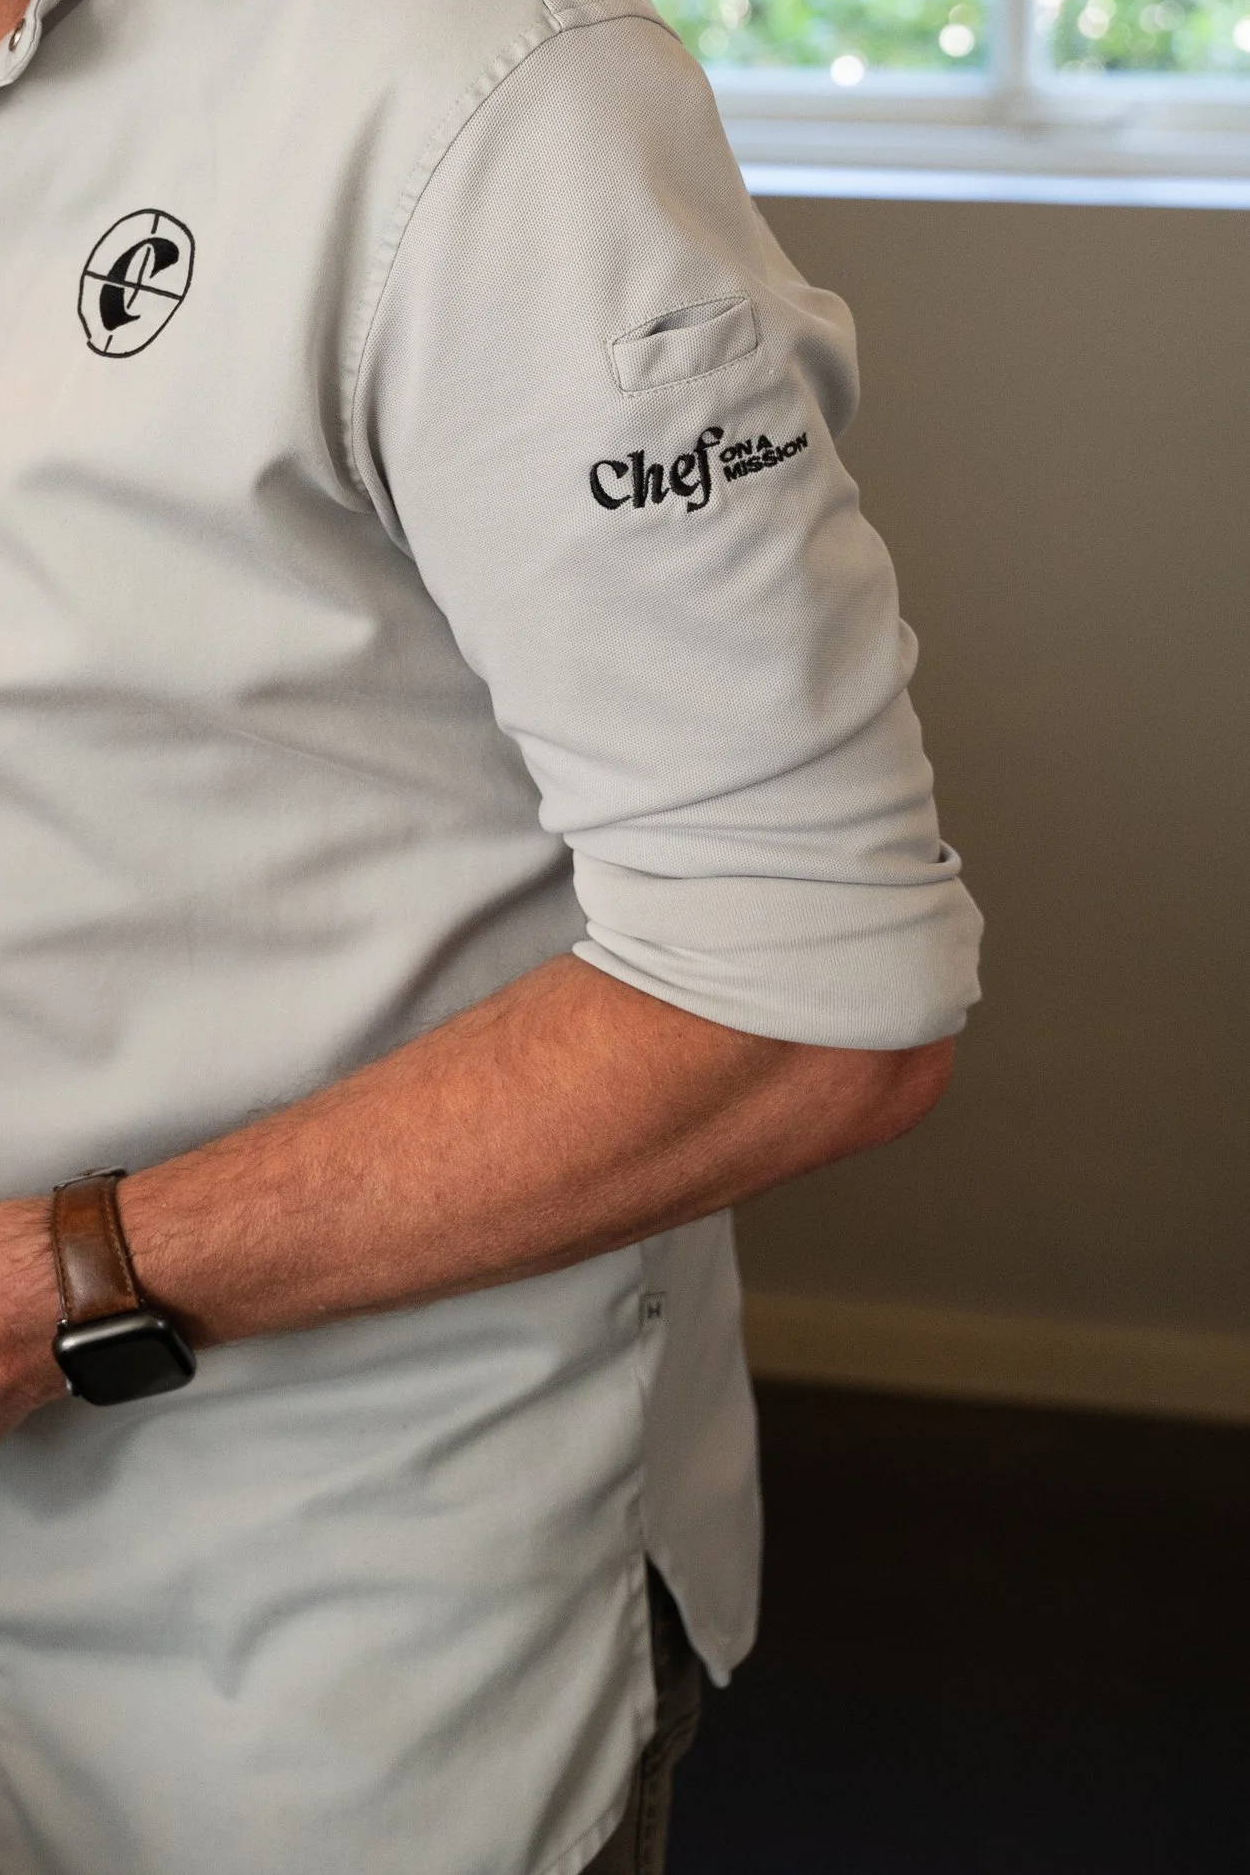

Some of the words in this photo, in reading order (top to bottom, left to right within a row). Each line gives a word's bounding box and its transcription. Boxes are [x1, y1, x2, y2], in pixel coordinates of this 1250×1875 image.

[588, 425, 725, 514] Chef
[718, 438, 754, 464] ON
[755, 433, 774, 453] A
[722, 431, 809, 483] MISSION
